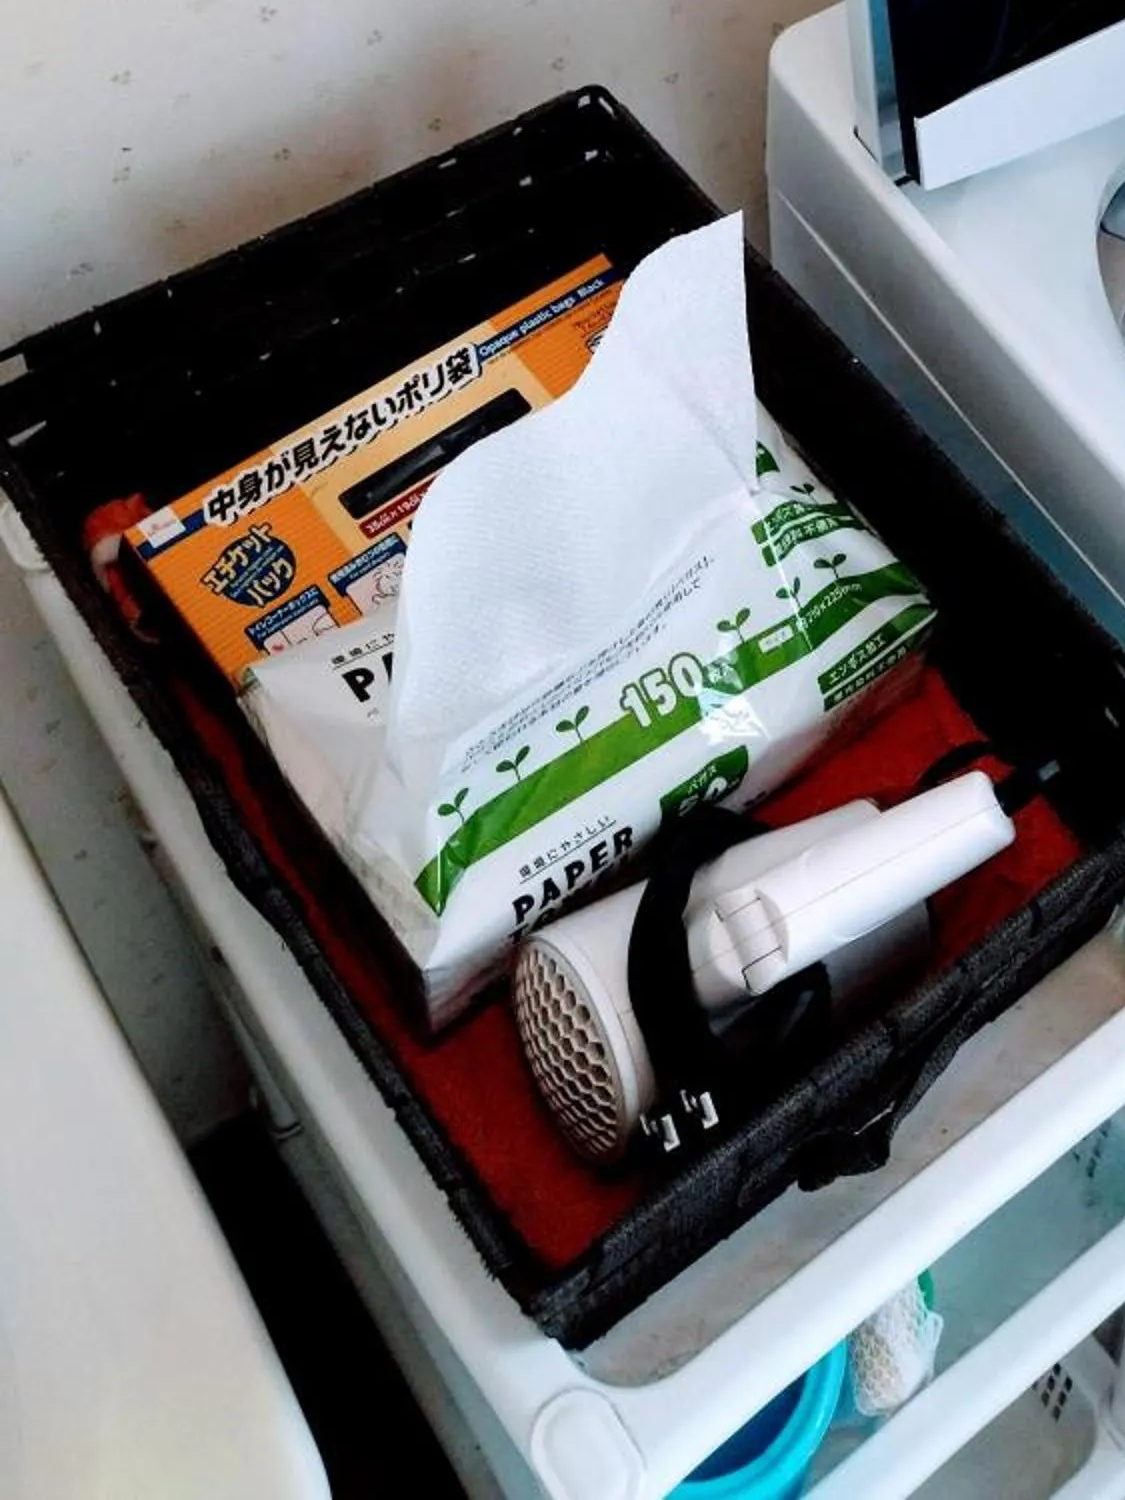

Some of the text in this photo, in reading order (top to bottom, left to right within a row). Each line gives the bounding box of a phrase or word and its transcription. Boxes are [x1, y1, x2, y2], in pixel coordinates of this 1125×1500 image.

[480, 329, 519, 358] Opaque
[519, 310, 553, 336] plastic
[576, 279, 604, 298] Black
[206, 347, 476, 523] 中身が見えないポリ袋
[202, 524, 273, 592] エチケット
[246, 557, 294, 607] パック
[620, 651, 704, 729] 150
[511, 825, 635, 925] PAPER
